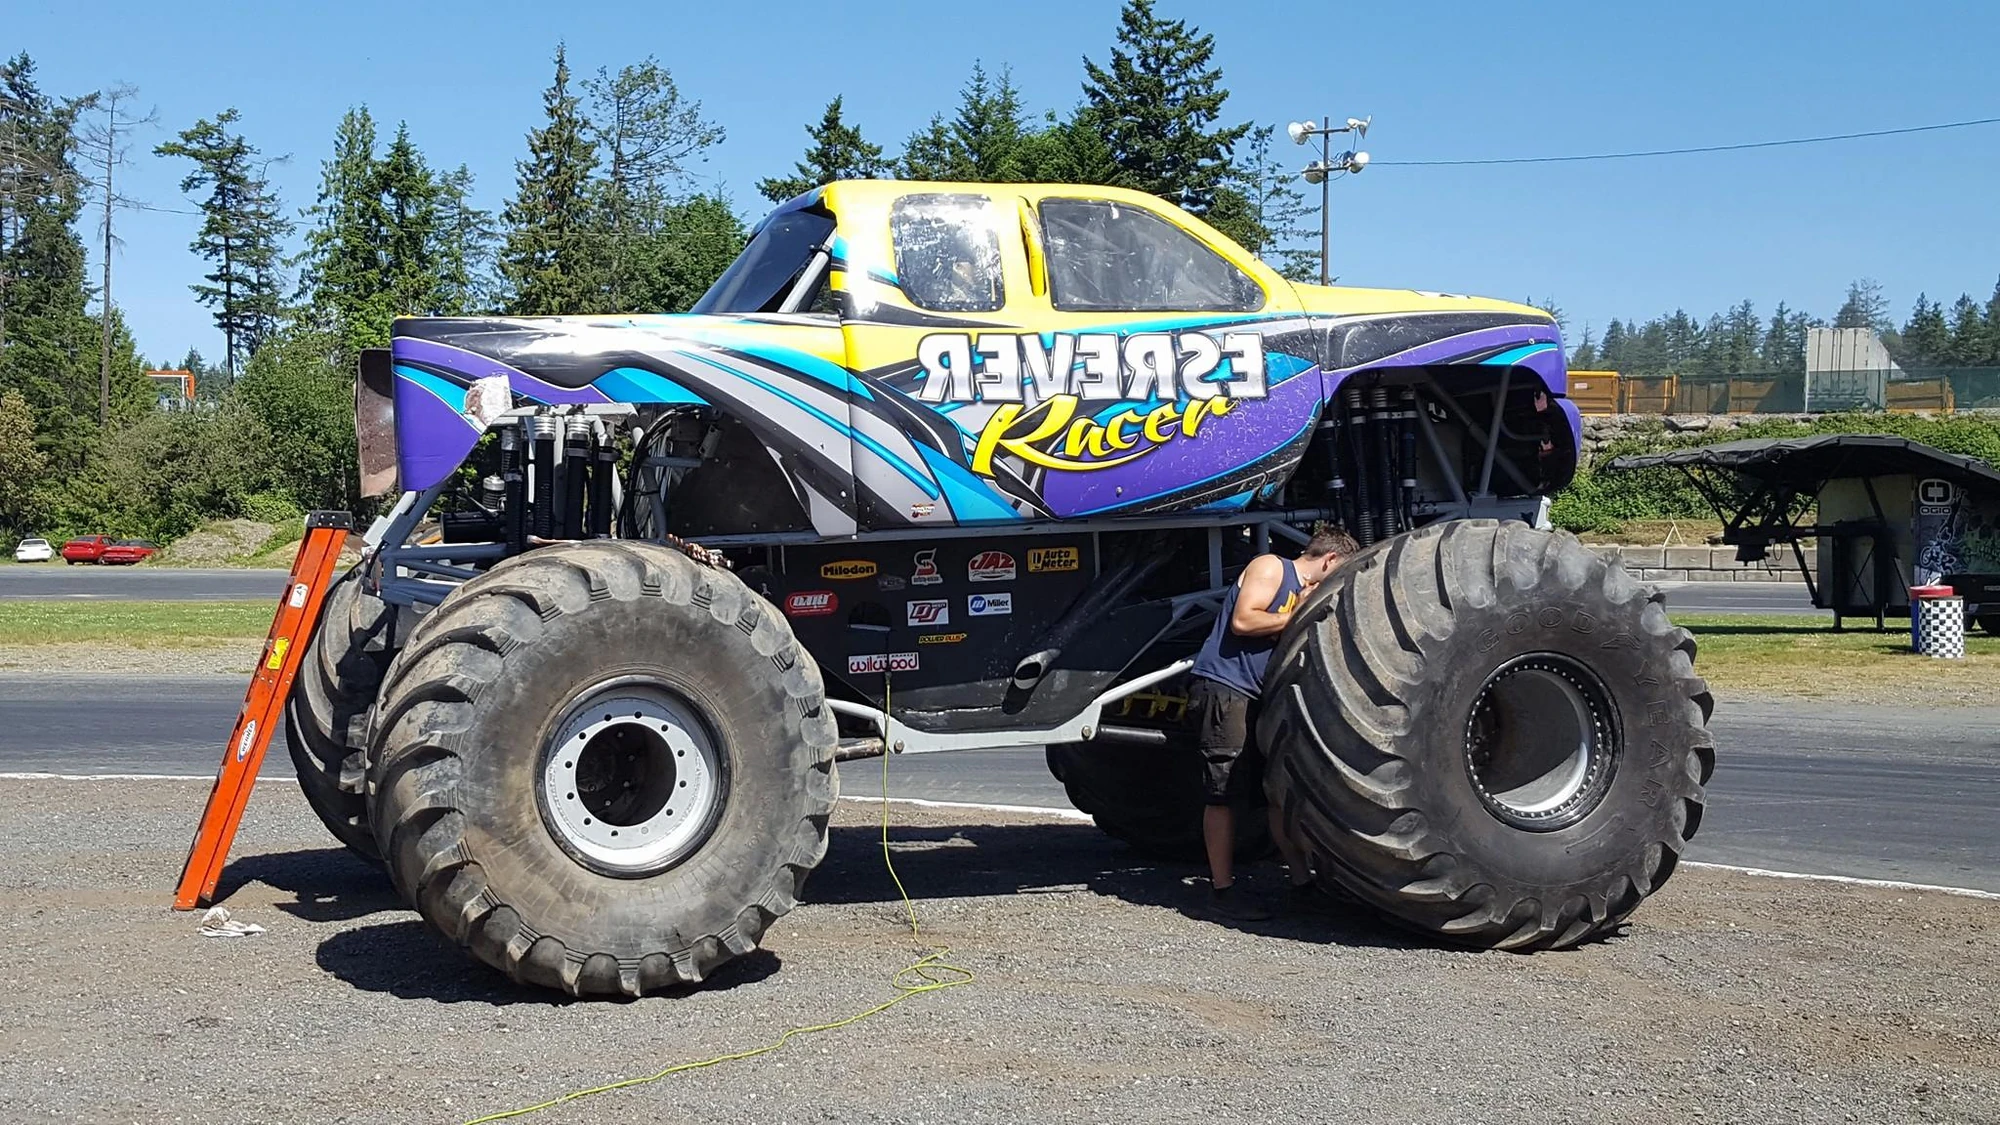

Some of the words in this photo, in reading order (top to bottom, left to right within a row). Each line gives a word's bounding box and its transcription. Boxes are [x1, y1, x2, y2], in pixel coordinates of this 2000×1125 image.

[971, 394, 1238, 477] Racer
[970, 552, 1015, 569] JAZ
[1043, 550, 1071, 559] Auto
[823, 564, 875, 576] Milodon
[1041, 559, 1076, 569] Meter
[987, 598, 1009, 607] Miller
[850, 653, 918, 672] wilwood
